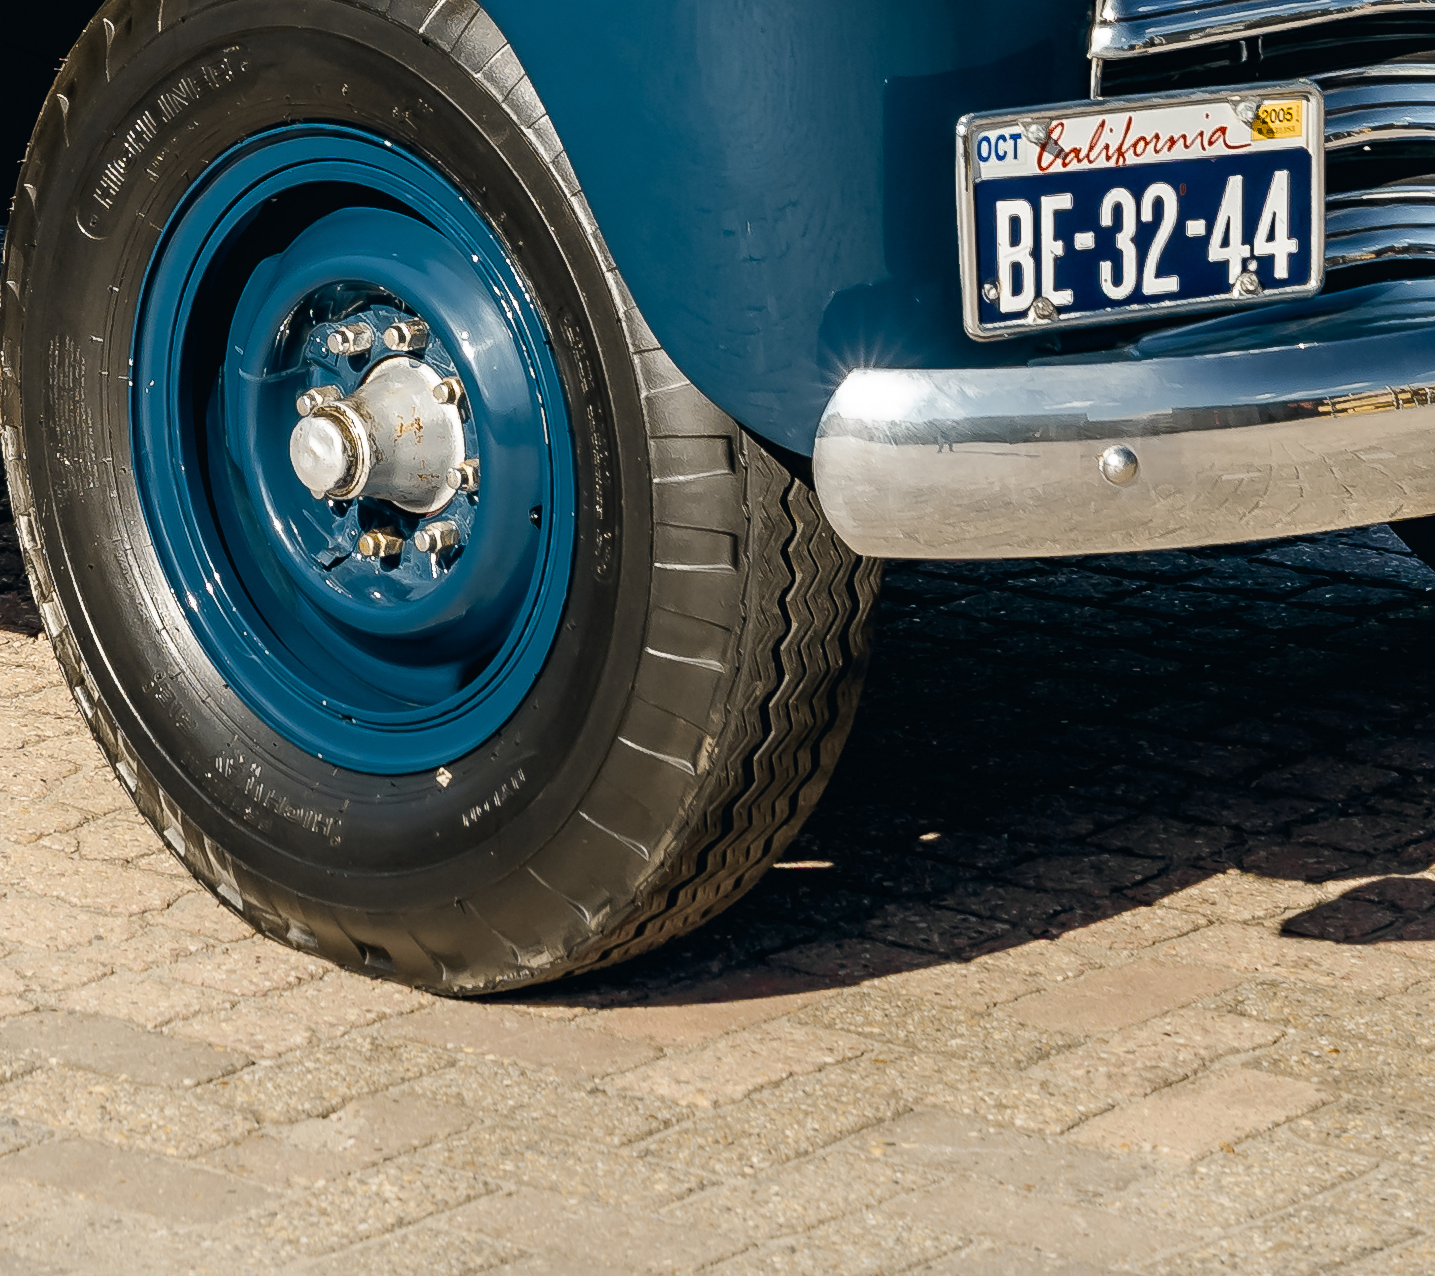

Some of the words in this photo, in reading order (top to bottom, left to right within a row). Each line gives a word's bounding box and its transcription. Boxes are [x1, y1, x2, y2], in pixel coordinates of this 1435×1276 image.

[976, 132, 1022, 163] OCT
[1036, 112, 1252, 173] California
[995, 169, 1299, 315] BE-32-44
